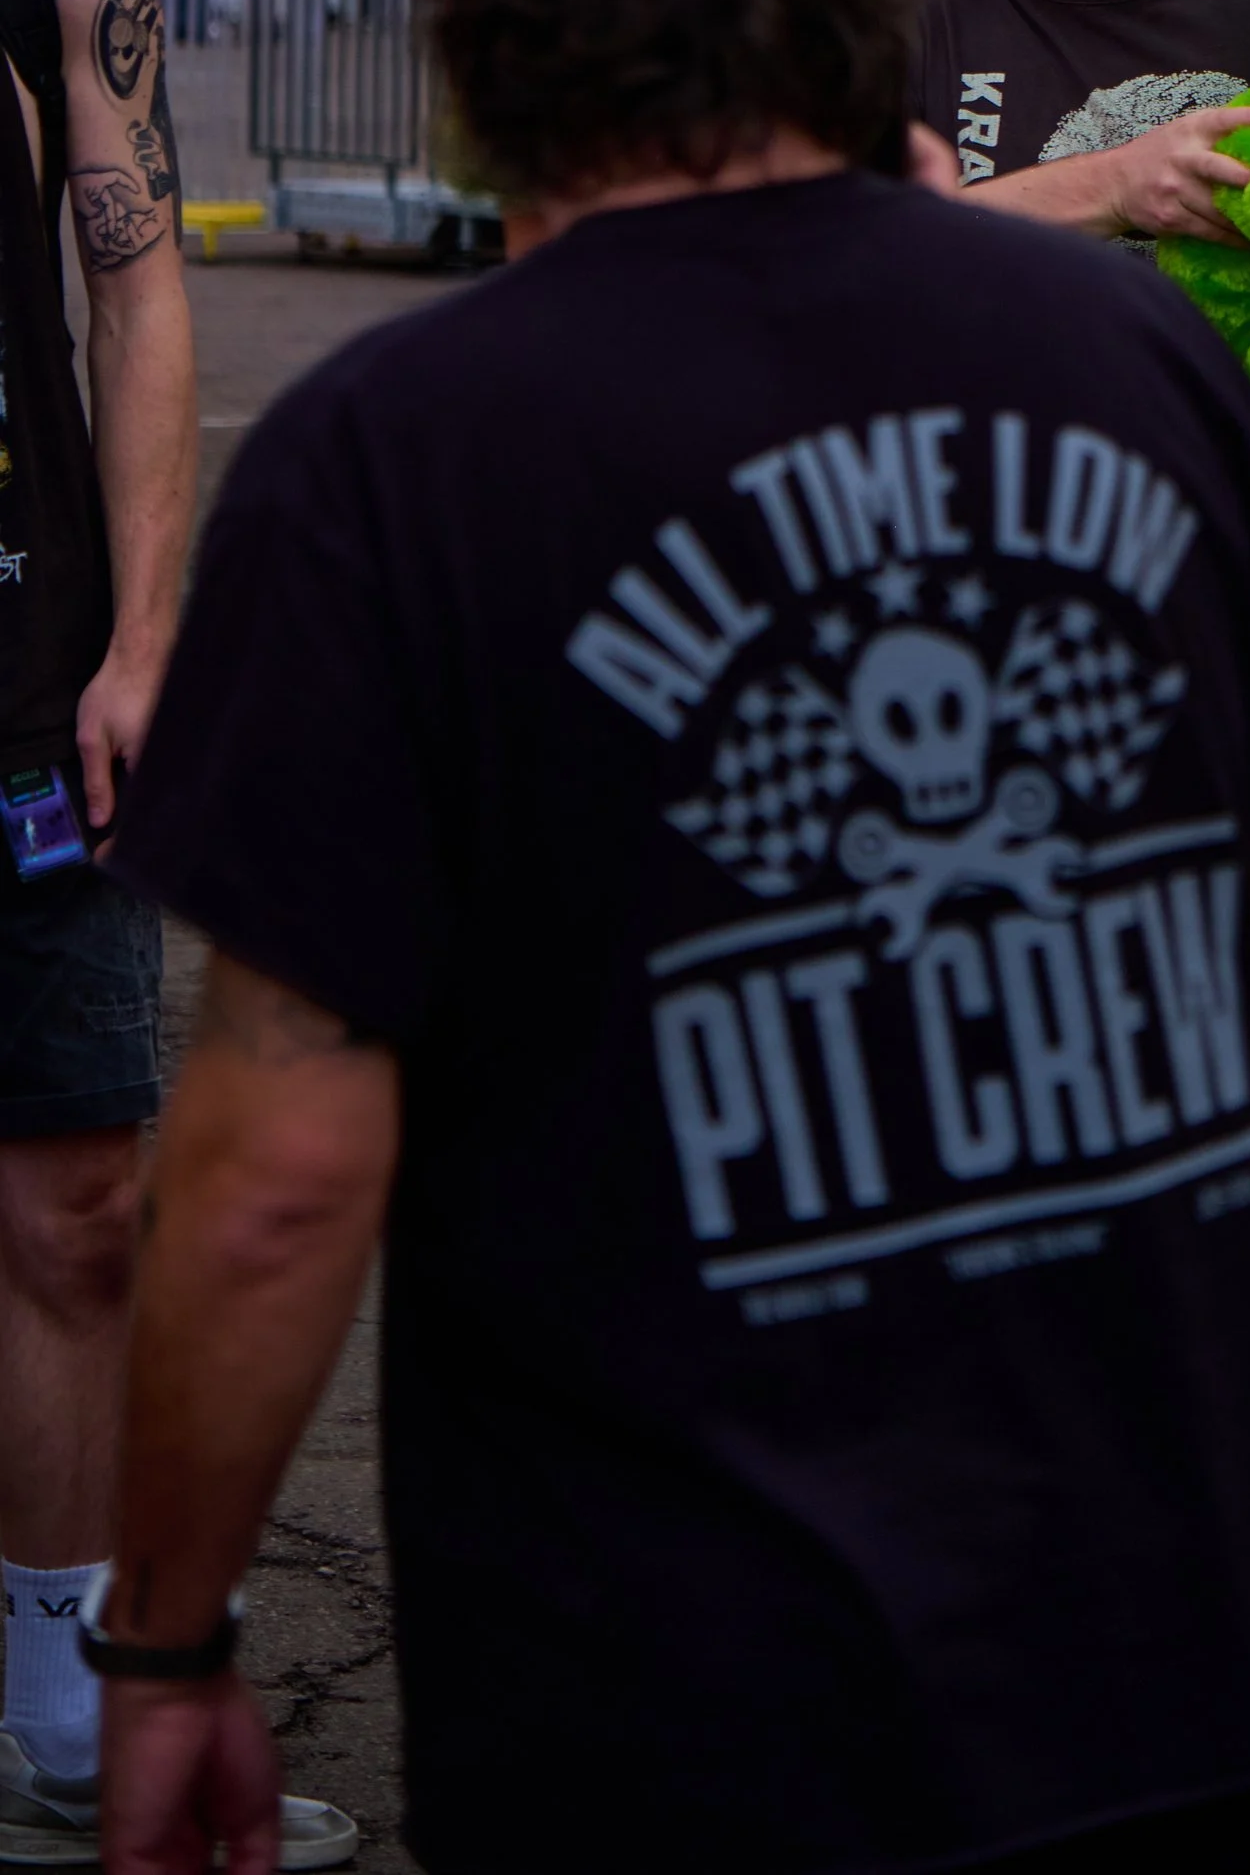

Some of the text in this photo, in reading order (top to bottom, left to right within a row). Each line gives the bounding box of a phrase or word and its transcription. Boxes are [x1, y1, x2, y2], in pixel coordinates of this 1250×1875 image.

[566, 407, 1197, 739] ALL TIME LOW
[652, 866, 1250, 1240] PIT CREW
